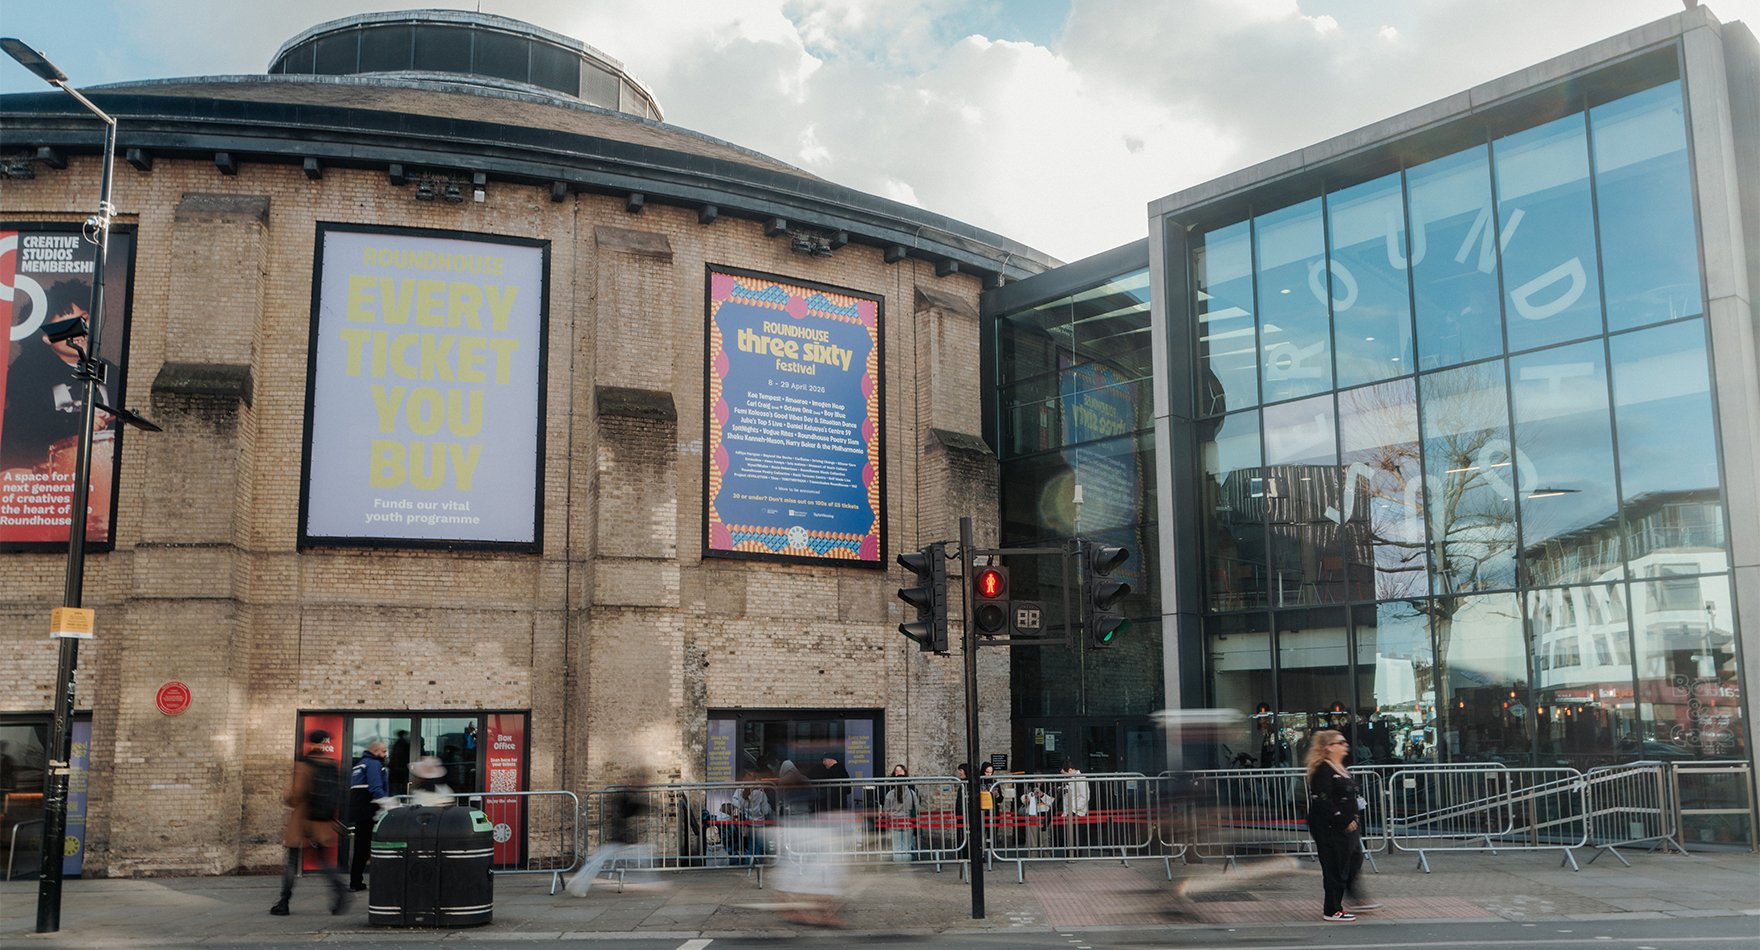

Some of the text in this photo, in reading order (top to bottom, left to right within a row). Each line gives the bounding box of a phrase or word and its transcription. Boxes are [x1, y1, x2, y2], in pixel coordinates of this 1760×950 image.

[23, 236, 79, 248] CREATIVE
[22, 249, 73, 260] STUDIOS
[363, 247, 504, 275] ROUNDHOUSE
[21, 261, 94, 272] MEMBERSHI
[346, 274, 518, 332] EVERY
[763, 321, 829, 343] ROUNDHOUSE
[737, 326, 853, 373] three sixty
[340, 328, 519, 385] TICKET
[776, 358, 816, 376] festival
[768, 379, 773, 387] 8
[791, 382, 807, 393] April
[759, 393, 781, 402] Tempest
[812, 400, 831, 409] Imogen
[370, 384, 484, 437] YOU
[824, 410, 834, 418] Boy
[758, 418, 767, 427] Top
[774, 412, 788, 420] Good
[803, 415, 813, 423] Day
[842, 420, 857, 428] Dance
[763, 428, 780, 437] Vogue
[798, 432, 829, 442] Roundhouse
[830, 436, 847, 445] Poetry
[369, 439, 483, 492] BUY
[4, 472, 12, 480] A
[15, 473, 49, 483] space
[52, 472, 69, 480] for
[3, 484, 29, 492] next
[2, 494, 70, 503] of creatives
[374, 498, 470, 511] Funds our vital
[1, 505, 71, 514] the heart of
[0, 516, 72, 525] Roundhouse
[365, 511, 480, 525] youth programme
[497, 734, 513, 742] Box
[493, 742, 516, 751] Office
